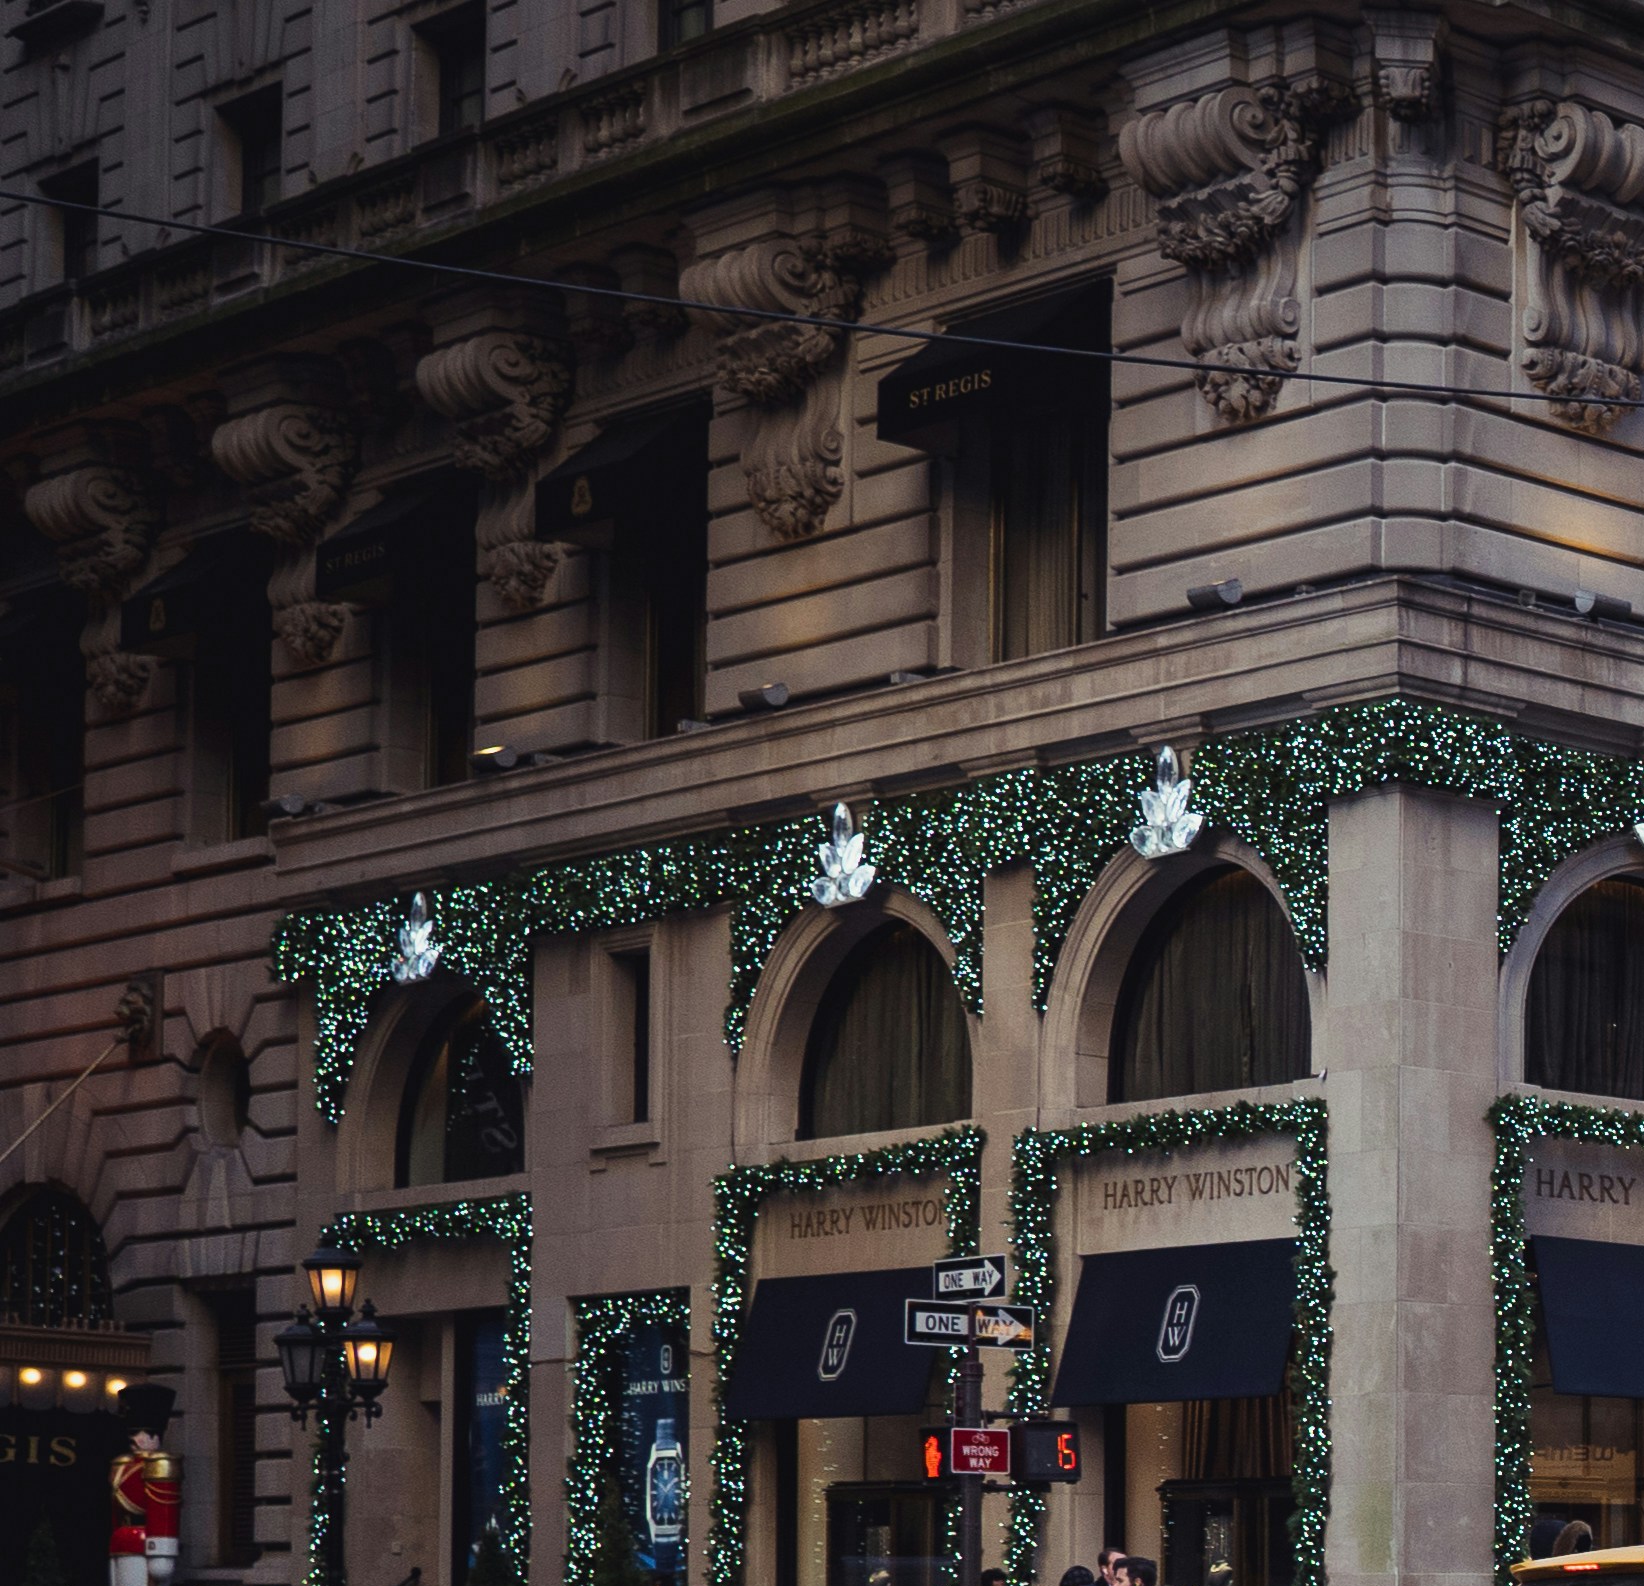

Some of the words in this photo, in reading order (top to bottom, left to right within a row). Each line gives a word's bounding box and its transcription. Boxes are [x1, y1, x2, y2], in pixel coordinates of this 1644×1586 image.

[934, 370, 992, 400] REGIS
[1104, 1175, 1177, 1210] HARRY
[1186, 1164, 1290, 1202] WINSTON
[1536, 1168, 1636, 1203] HARRY
[790, 1208, 854, 1239] HARRY
[943, 1271, 964, 1290] ONE
[973, 1269, 994, 1287] WAY
[925, 1314, 961, 1332] ONE
[978, 1317, 1014, 1336] WAY
[629, 1380, 659, 1395] HARRY
[962, 1445, 999, 1457] WRONG
[969, 1458, 992, 1468] WAY
